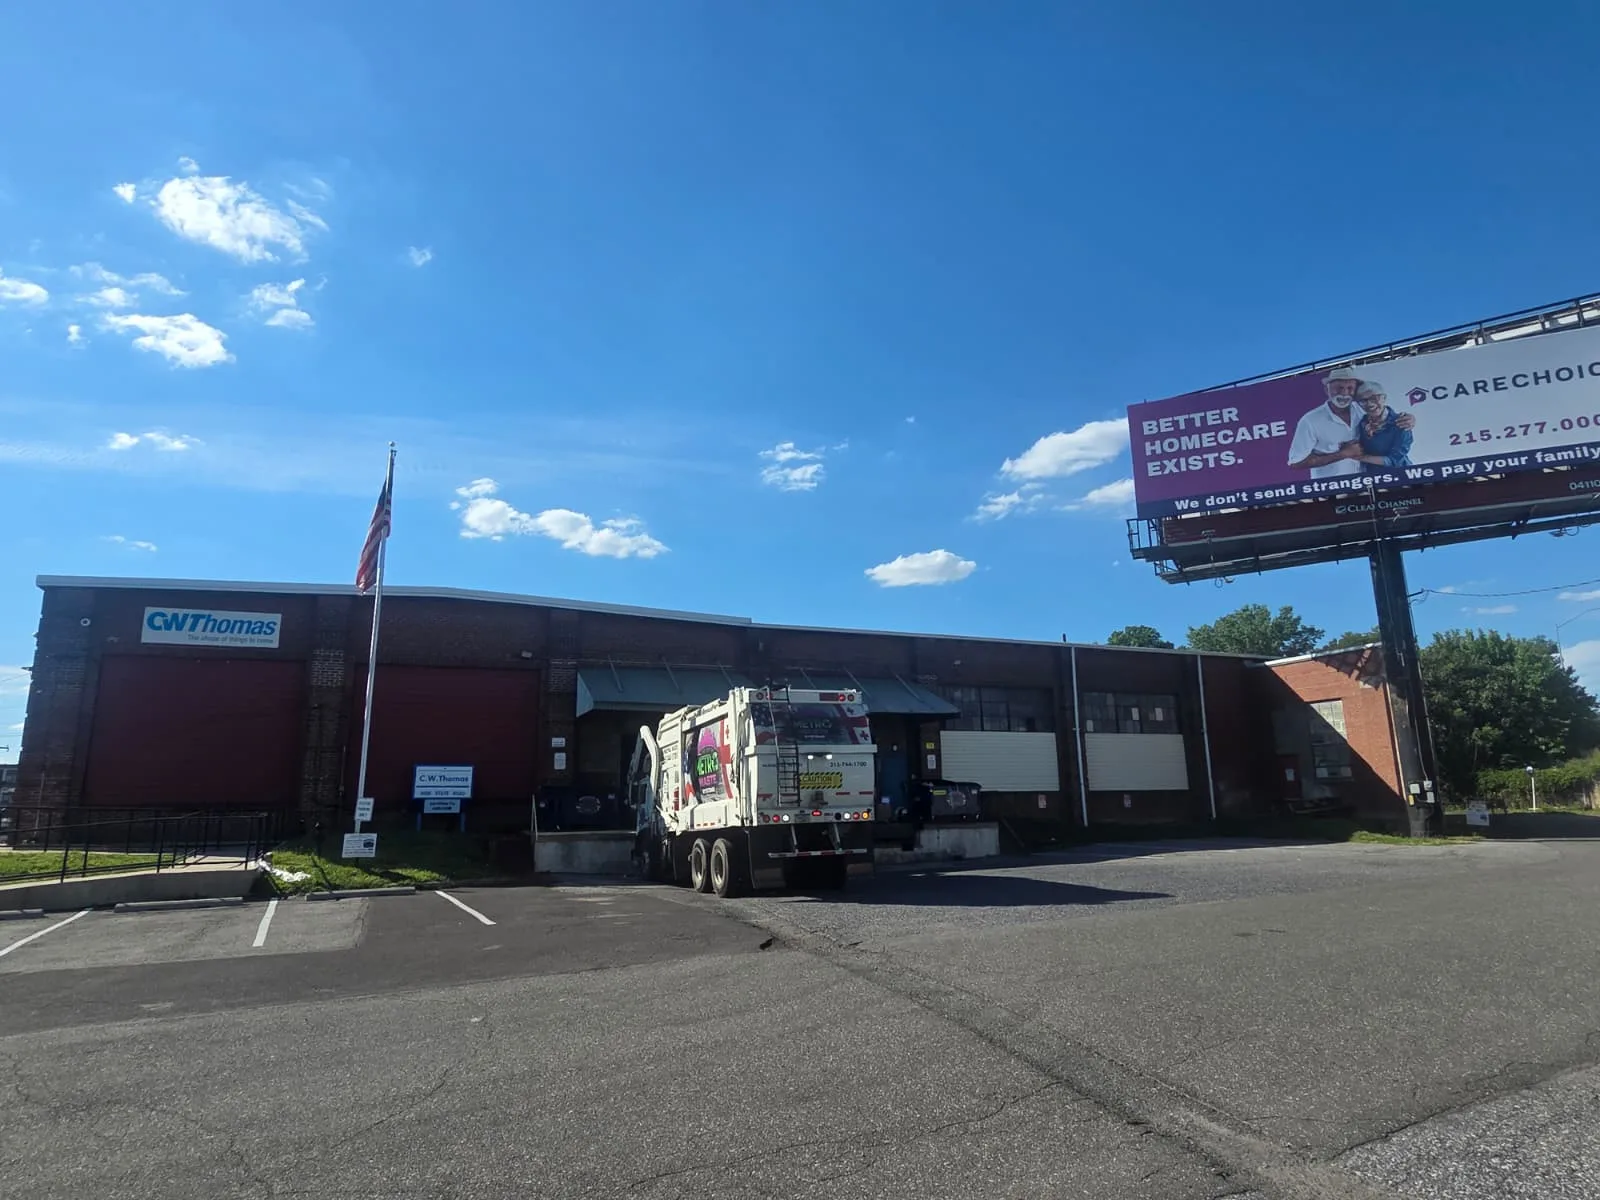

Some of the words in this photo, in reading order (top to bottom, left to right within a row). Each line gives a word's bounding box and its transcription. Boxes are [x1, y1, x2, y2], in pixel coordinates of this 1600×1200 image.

[1142, 407, 1240, 435] BETTER
[1145, 421, 1287, 456] HOMECARE
[1147, 450, 1244, 477] EXISTS.
[1174, 499, 1200, 511] We
[1205, 491, 1249, 507] don't
[1254, 485, 1296, 500] send
[1302, 473, 1399, 493] strangers.
[1404, 467, 1435, 480] We
[1441, 462, 1476, 478] pay
[1484, 455, 1529, 473] your
[1535, 446, 1600, 464] family
[146, 611, 278, 636] CWThomas
